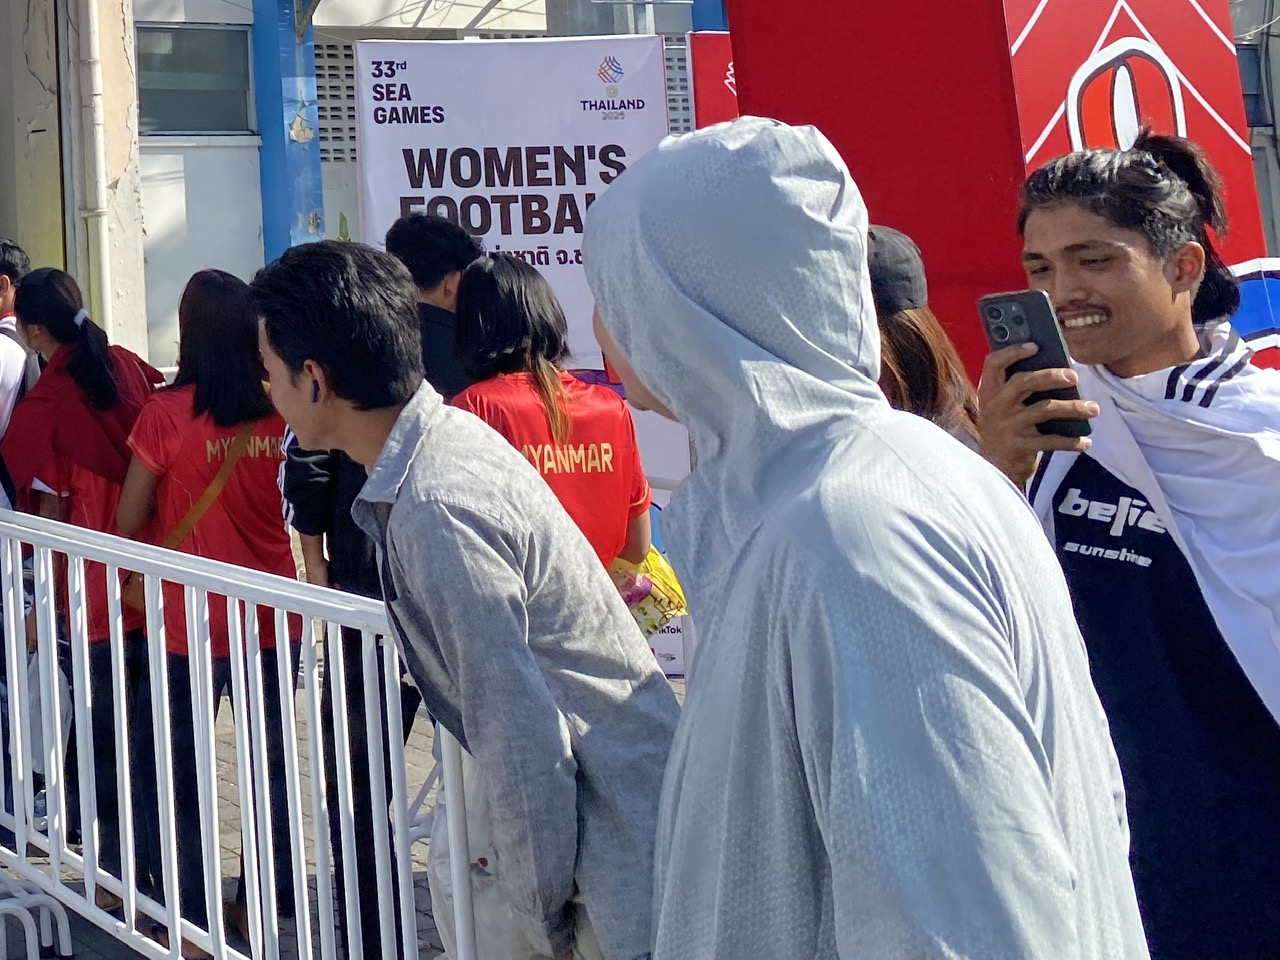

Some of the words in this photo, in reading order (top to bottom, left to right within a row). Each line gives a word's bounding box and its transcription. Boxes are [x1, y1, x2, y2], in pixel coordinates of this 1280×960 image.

[371, 60, 407, 78] 33rd
[372, 83, 412, 102] SEA
[580, 99, 645, 111] THAILAND
[373, 106, 445, 125] GAMES
[402, 144, 627, 188] WOMEN'S
[521, 442, 614, 475] YANMAR
